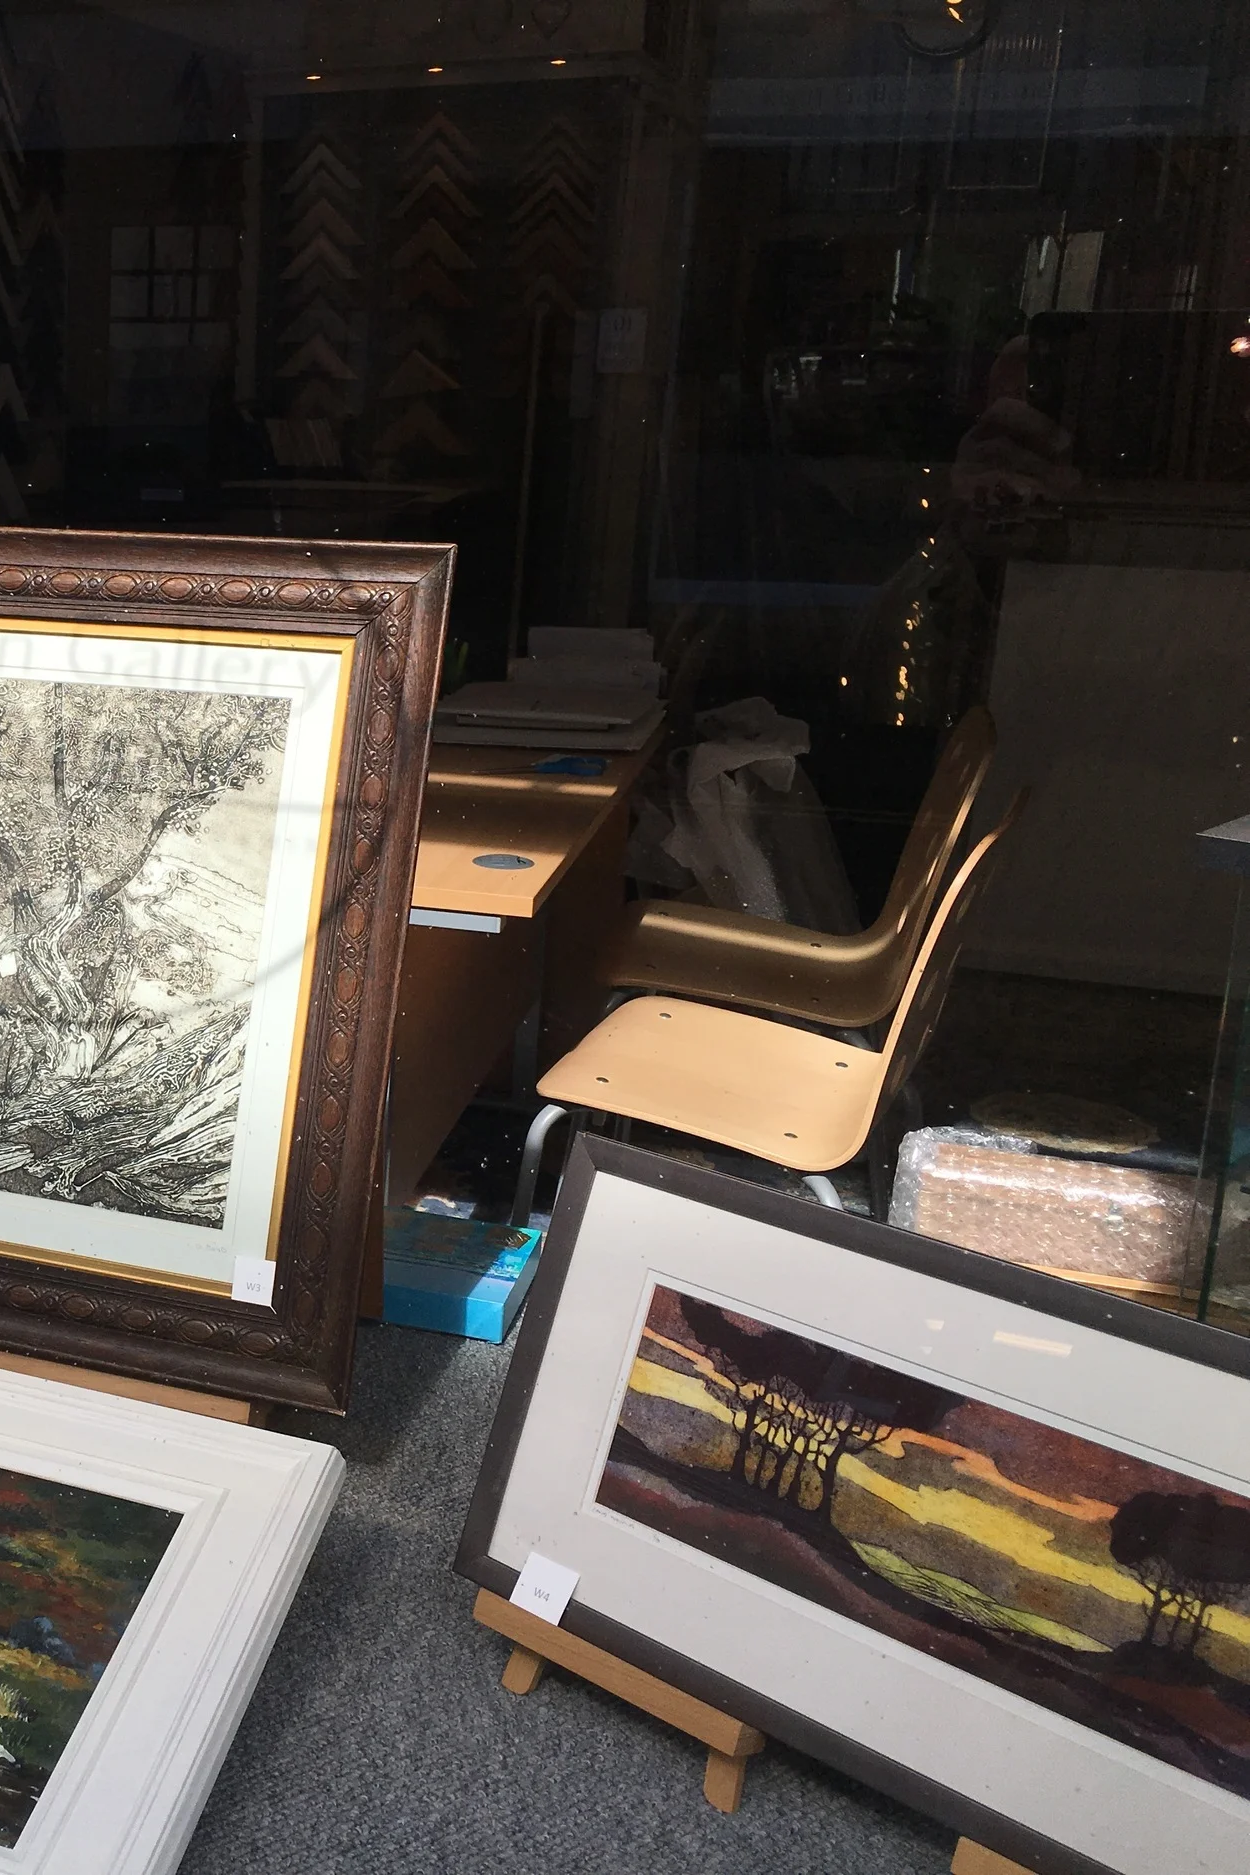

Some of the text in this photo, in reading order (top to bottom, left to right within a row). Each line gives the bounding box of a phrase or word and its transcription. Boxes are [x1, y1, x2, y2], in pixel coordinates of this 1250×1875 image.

[66, 626, 338, 716] Gallery
[246, 1282, 261, 1292] W3
[534, 1587, 550, 1602] W4
